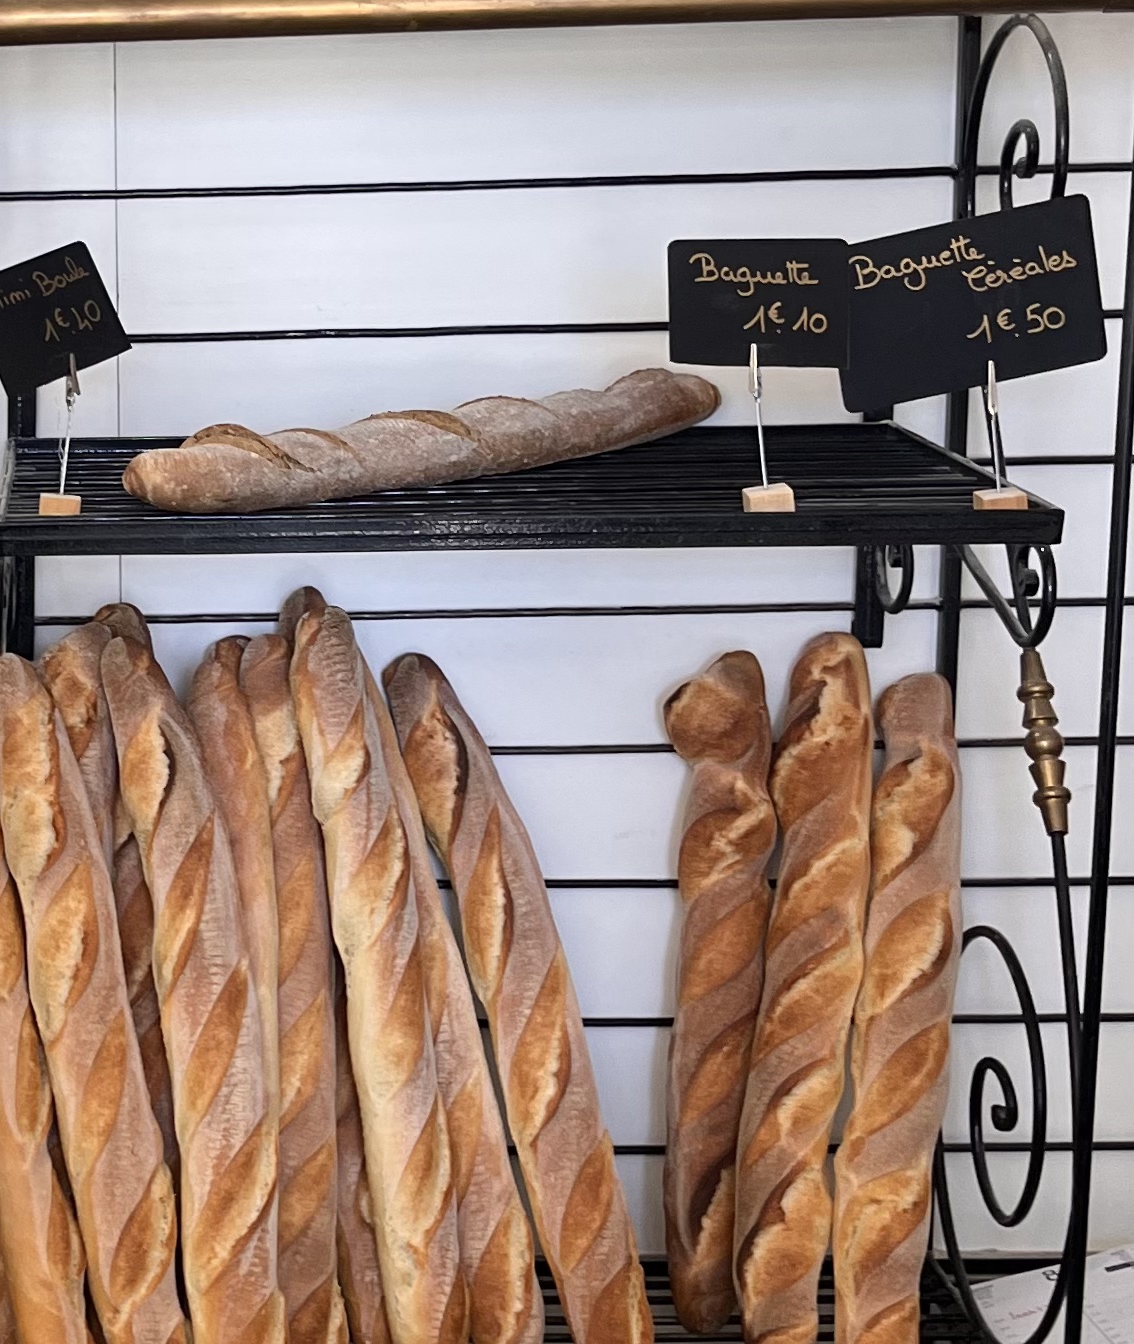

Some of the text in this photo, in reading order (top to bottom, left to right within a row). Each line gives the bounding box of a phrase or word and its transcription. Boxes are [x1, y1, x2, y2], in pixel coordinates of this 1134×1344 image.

[32, 256, 90, 296] Boule
[689, 253, 818, 296] Baguette
[849, 236, 985, 291] Baguette
[962, 246, 1077, 291] Céréales
